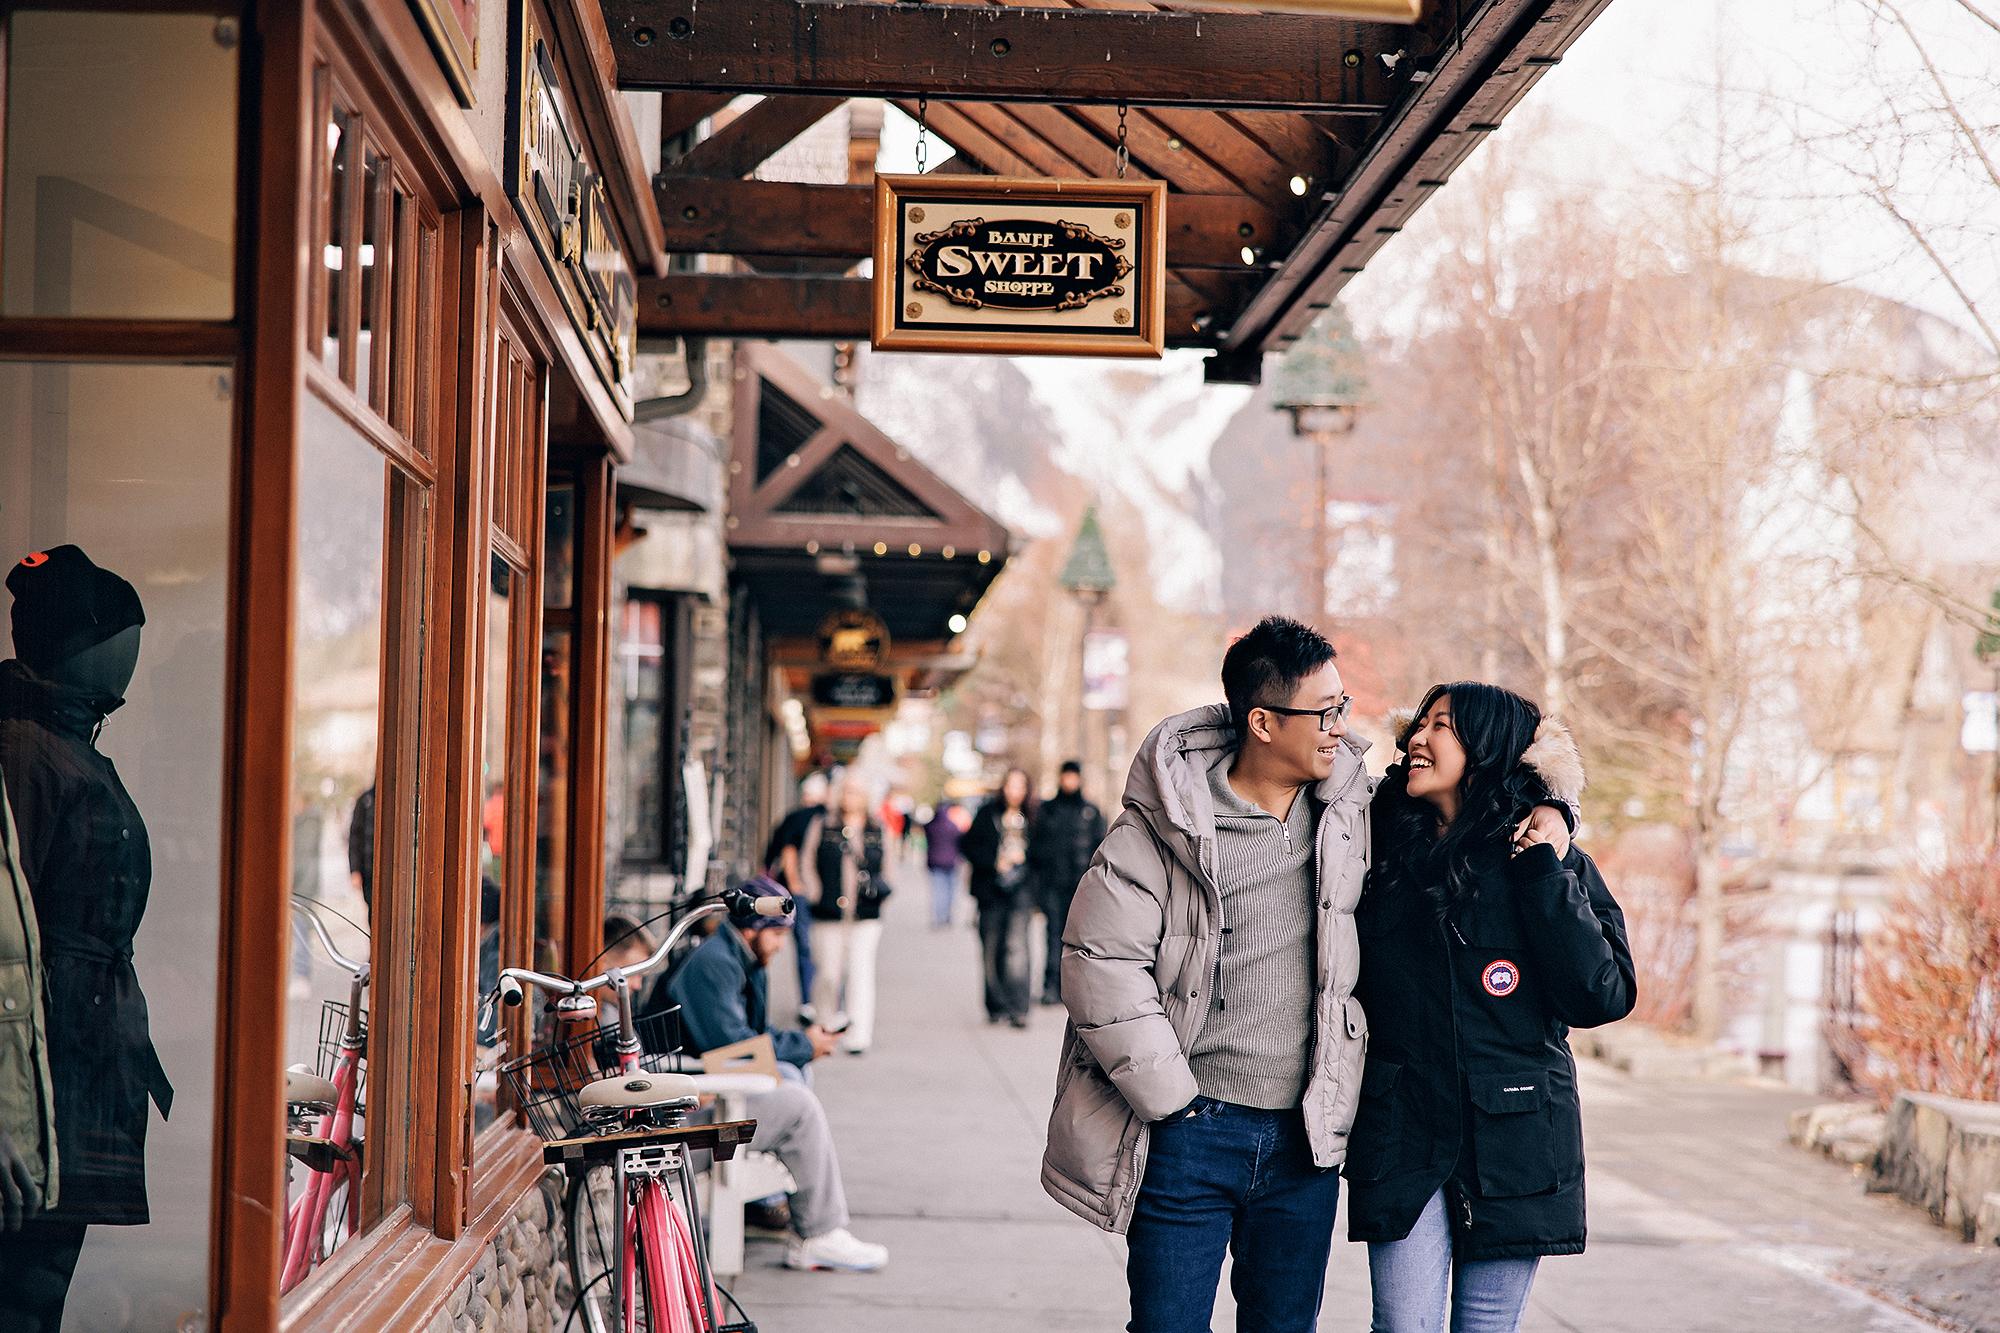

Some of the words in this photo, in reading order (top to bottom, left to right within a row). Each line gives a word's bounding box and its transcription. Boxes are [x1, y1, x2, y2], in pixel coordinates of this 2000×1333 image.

[988, 231, 1053, 247] BANFF
[937, 246, 1103, 279] SWEET
[984, 280, 1055, 297] SHOPPE
